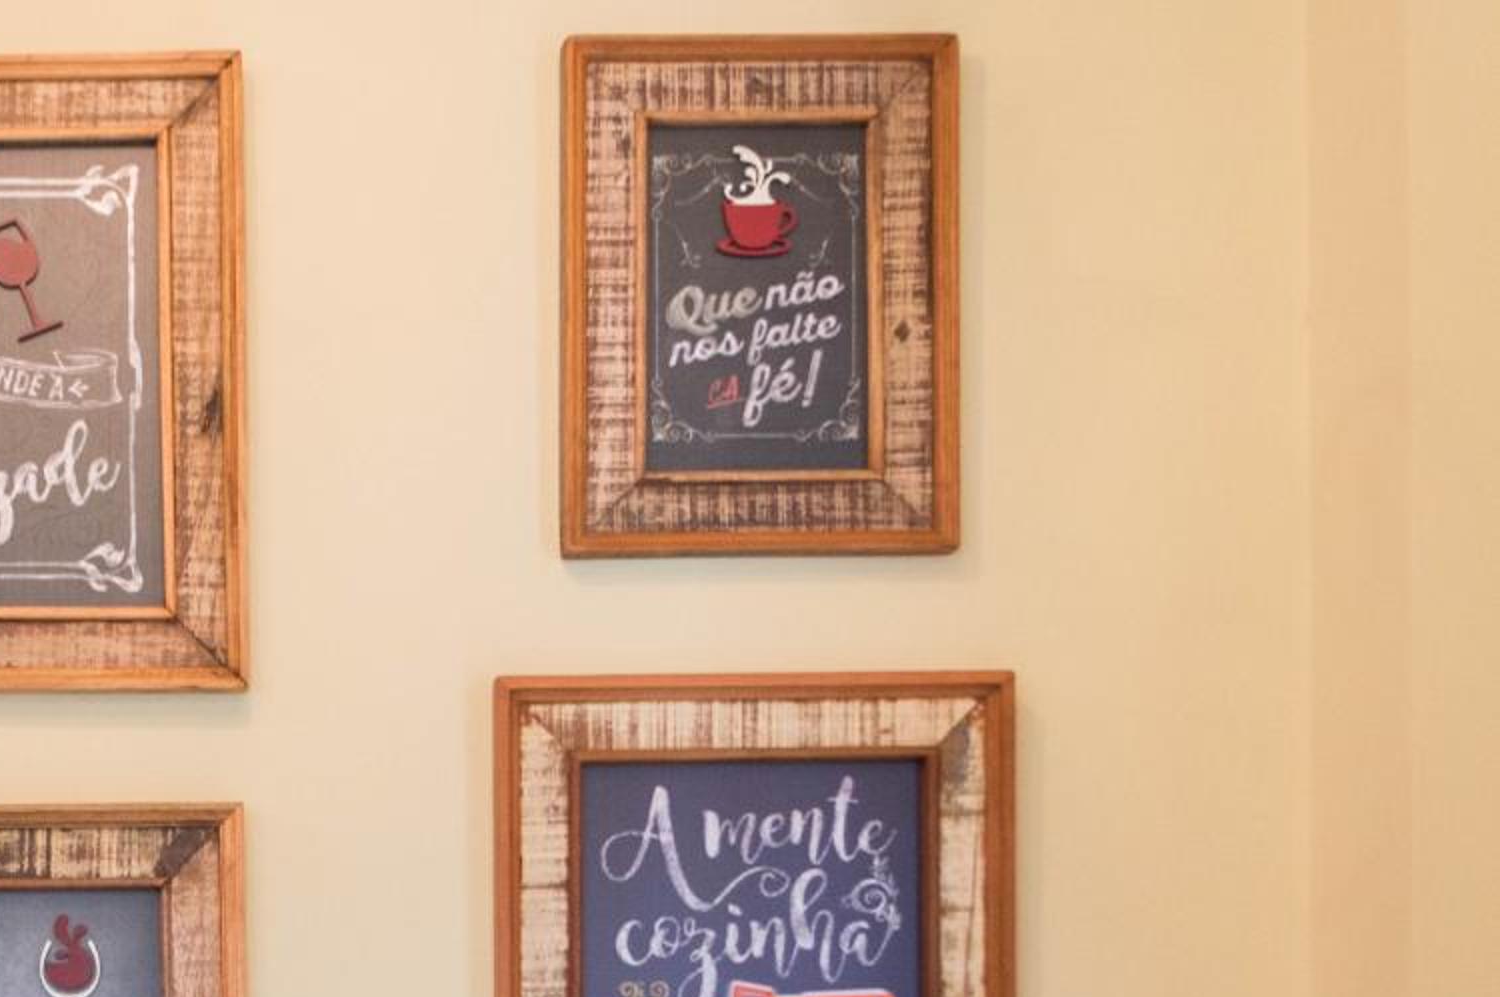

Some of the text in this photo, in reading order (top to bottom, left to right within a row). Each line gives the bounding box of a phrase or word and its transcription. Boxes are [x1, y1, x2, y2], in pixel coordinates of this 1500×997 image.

[665, 271, 844, 334] Que não
[669, 313, 841, 368] nos falte
[601, 776, 897, 911] A mente
